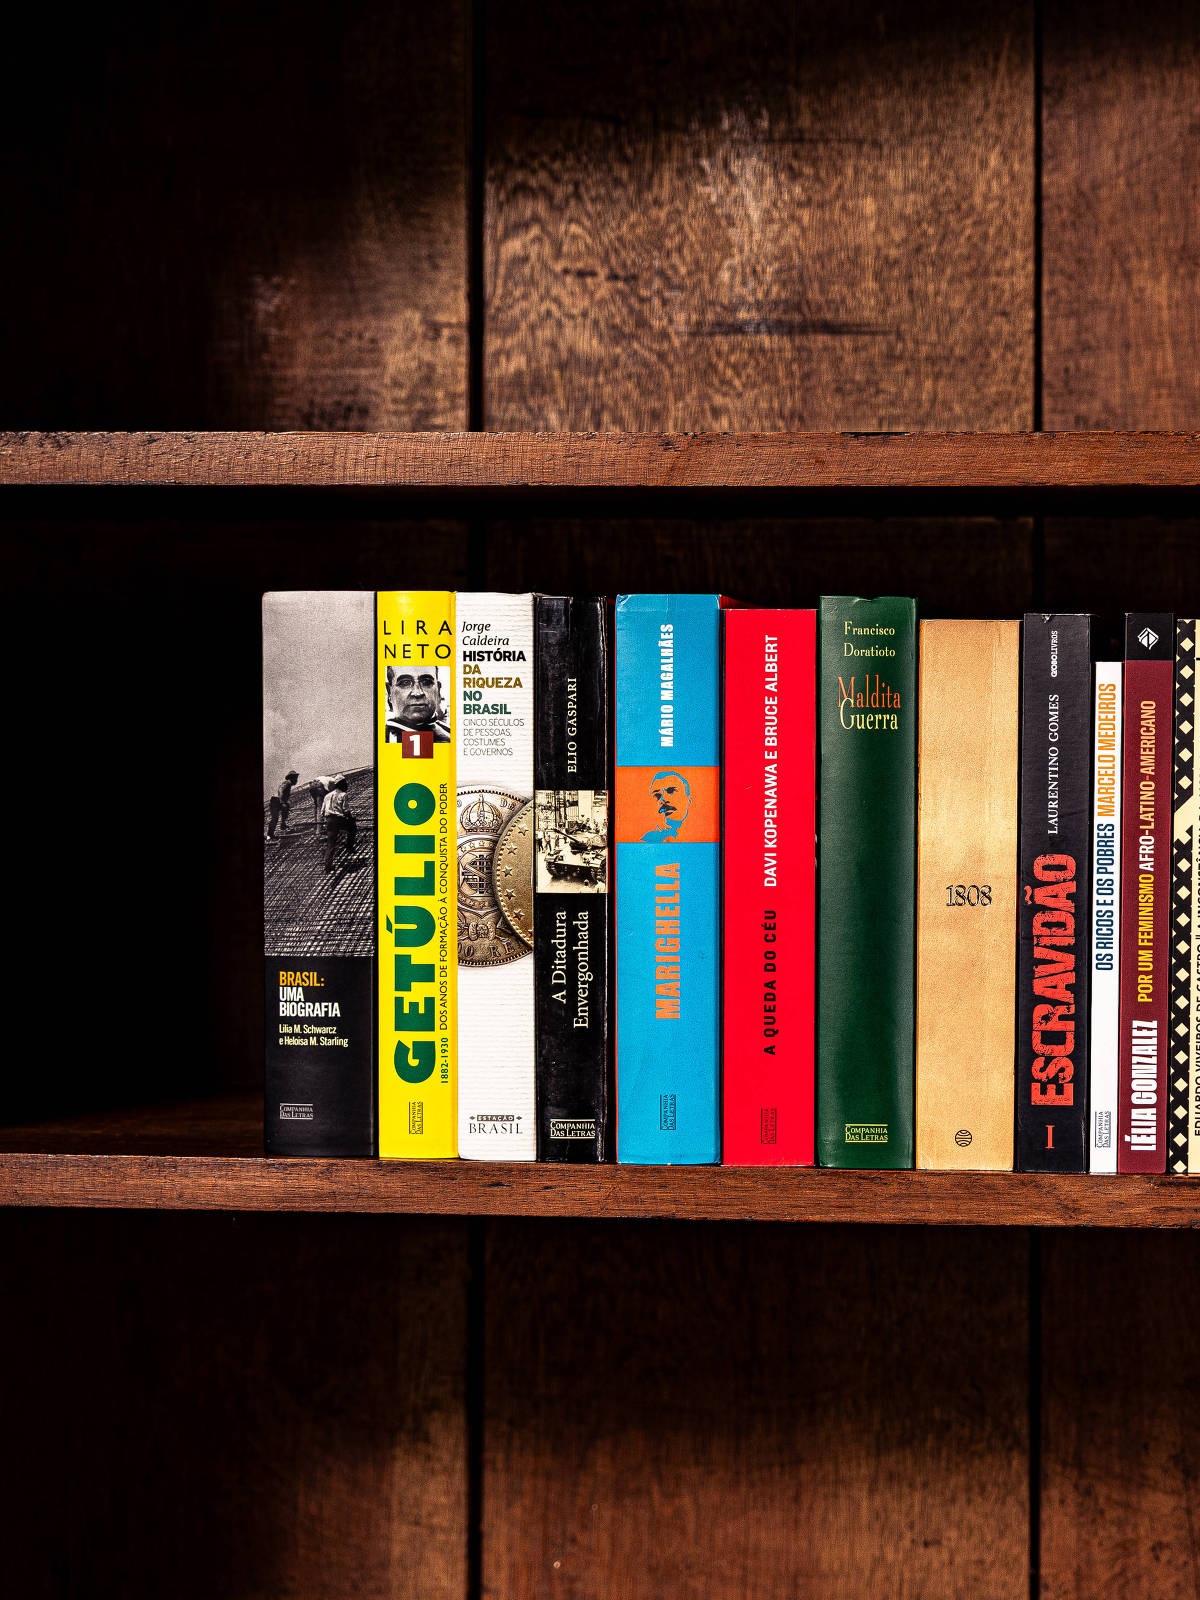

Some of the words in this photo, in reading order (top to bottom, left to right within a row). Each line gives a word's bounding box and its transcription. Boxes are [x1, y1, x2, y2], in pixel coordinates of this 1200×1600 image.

[383, 620, 453, 636] LIRA
[461, 621, 491, 634] Jorge
[462, 635, 510, 646] Caldeira
[843, 620, 895, 635] Francisco
[384, 644, 451, 659] NETO
[463, 648, 526, 662] HISTÓRIA
[658, 624, 673, 700] MAGALHÃES
[765, 635, 778, 692] ALBERT
[843, 642, 896, 658] Doratioto
[463, 664, 482, 675] DA
[463, 677, 523, 689] RIQUEZA
[463, 690, 482, 701] NO
[837, 674, 901, 708] Maldita
[463, 703, 512, 715] BRASIL
[567, 678, 577, 736] GASPARI
[765, 696, 778, 746] BRUCE
[840, 697, 898, 731] Guerra
[1048, 694, 1059, 742] GOMES
[1098, 683, 1116, 751] MEDEIROS
[658, 705, 674, 747] MÁRIO
[409, 734, 420, 756] 1
[567, 741, 577, 773] ELIO
[765, 751, 777, 759] E
[1048, 747, 1059, 834] LAURENTINO
[1097, 754, 1116, 817] MARCELO
[1139, 701, 1156, 871] AFRO-LATINO-AMERICANO
[764, 764, 777, 848] KOPENAWA
[1096, 823, 1115, 875] POBRES
[764, 853, 777, 886] DAVI
[946, 884, 992, 907] 1808
[1096, 878, 1114, 896] OS
[1138, 874, 1154, 946] FEMINISMO
[386, 783, 436, 1084] GETÚLIO
[655, 863, 680, 1019] MARIGHELLA
[761, 910, 776, 943] CÉU
[1096, 910, 1114, 949] RICOS
[551, 911, 567, 985] Ditadura
[764, 950, 776, 972] DO
[1095, 953, 1113, 971] OS
[1138, 950, 1153, 971] UM
[279, 971, 324, 989] BRASIL:
[572, 911, 593, 1028] Envergonhada
[1024, 854, 1076, 1106] ESCRAVIDÃO
[279, 987, 305, 1002] UMA
[552, 990, 566, 1004] A
[1137, 975, 1153, 1002] POR
[279, 1002, 341, 1017] BIOGRAFIA
[763, 980, 779, 1038] QUEDA
[279, 1024, 293, 1034] Lilia
[294, 1024, 302, 1034] M.
[303, 1024, 337, 1034] Schwarcz
[284, 1036, 308, 1046] Heloisa
[309, 1036, 319, 1046] M.
[319, 1036, 349, 1048] Starling
[763, 1045, 776, 1056] A
[1131, 1020, 1158, 1104] GONZALEZ
[469, 1123, 522, 1134] BRASIL
[1124, 1108, 1156, 1151] LÉLIA
